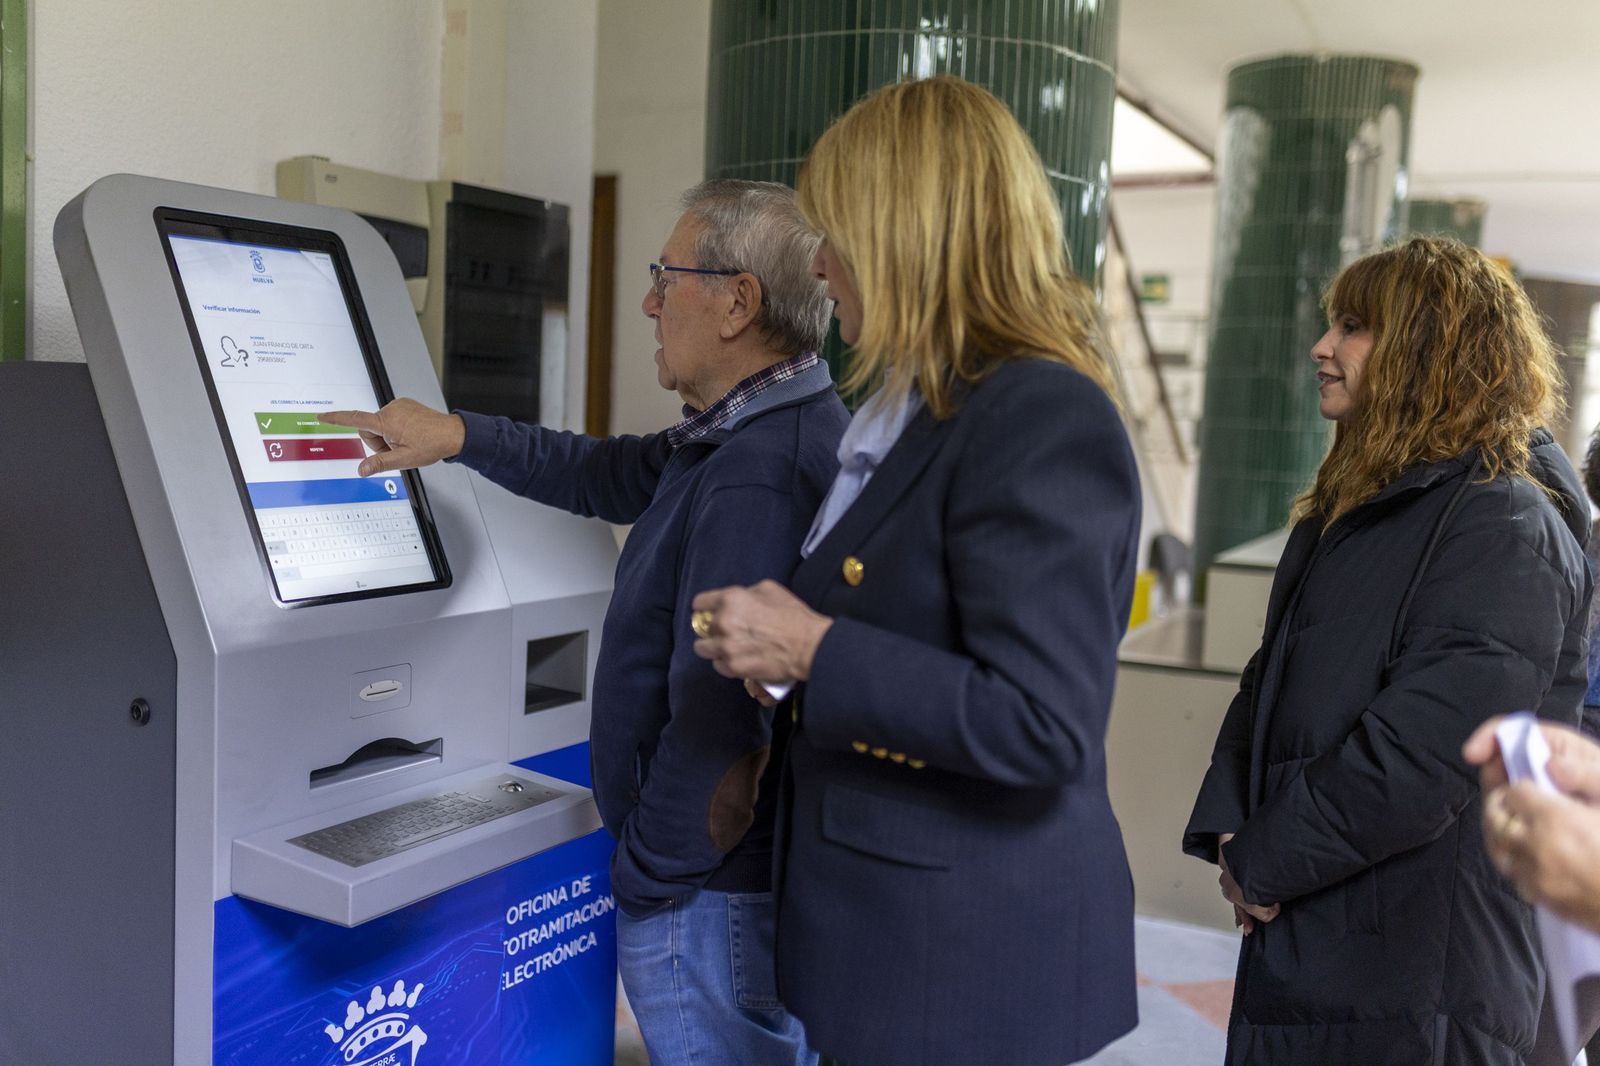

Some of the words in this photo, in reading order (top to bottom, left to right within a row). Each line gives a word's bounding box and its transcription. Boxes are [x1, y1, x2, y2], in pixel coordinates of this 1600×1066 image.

[227, 306, 261, 315] información
[506, 886, 568, 925] OFICINA
[571, 875, 592, 898] DE
[502, 931, 597, 990] LECTRÓNICA
